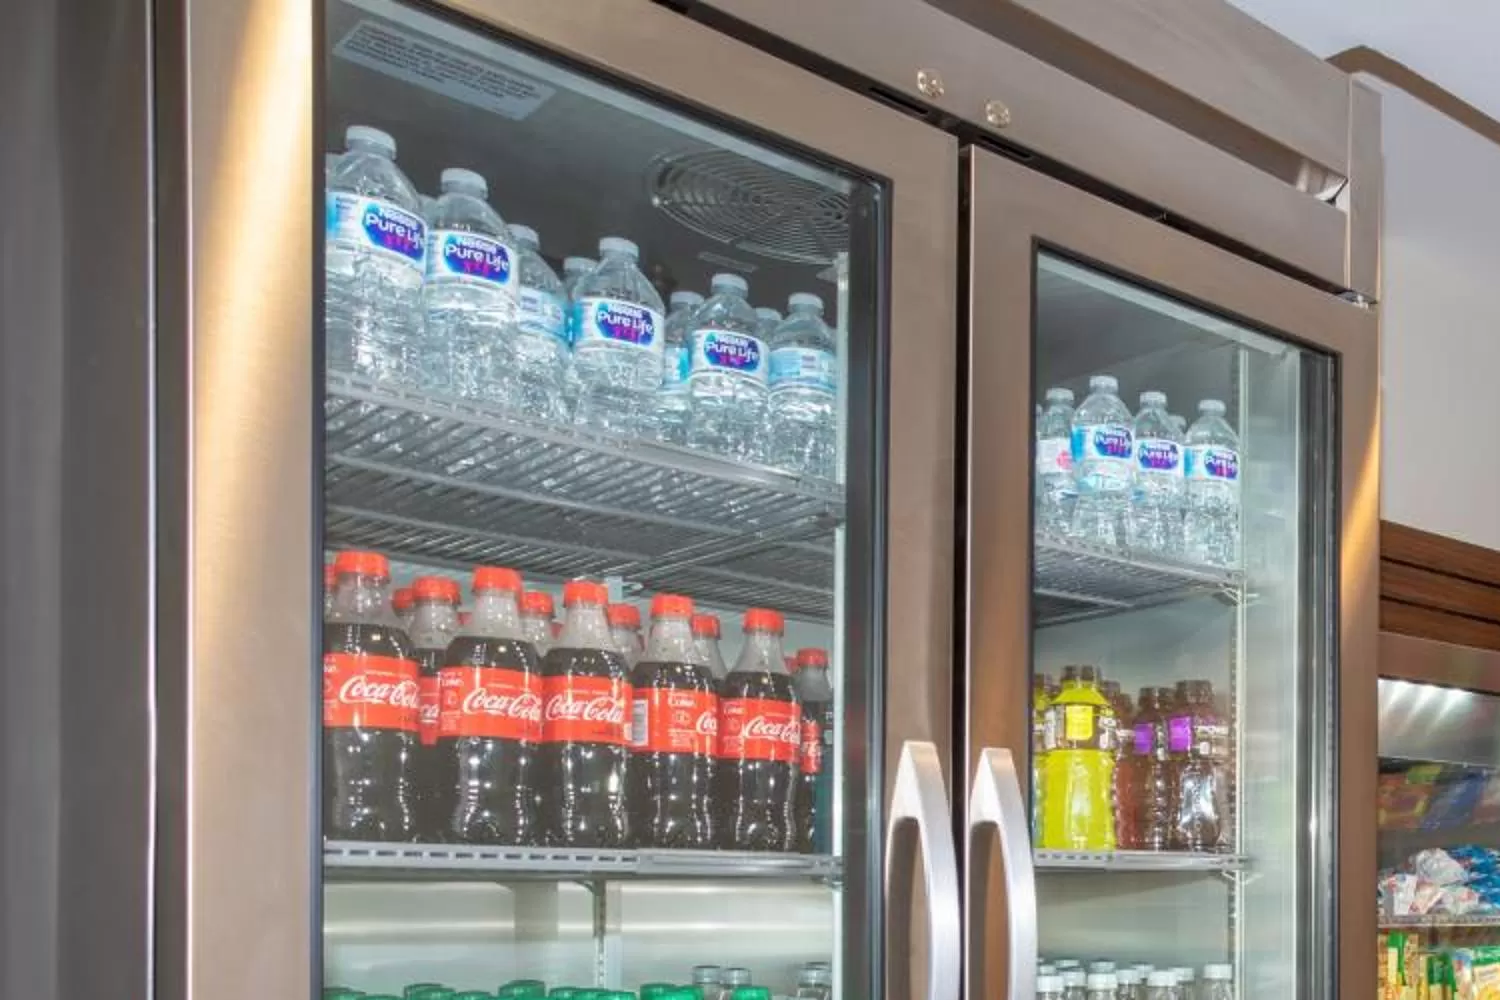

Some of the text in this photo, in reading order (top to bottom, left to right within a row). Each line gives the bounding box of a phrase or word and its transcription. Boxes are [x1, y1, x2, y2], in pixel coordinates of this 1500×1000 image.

[365, 212, 406, 238] Pure
[445, 242, 509, 273] Pure Life
[597, 309, 654, 336] Pure Life
[705, 341, 738, 358] Pure
